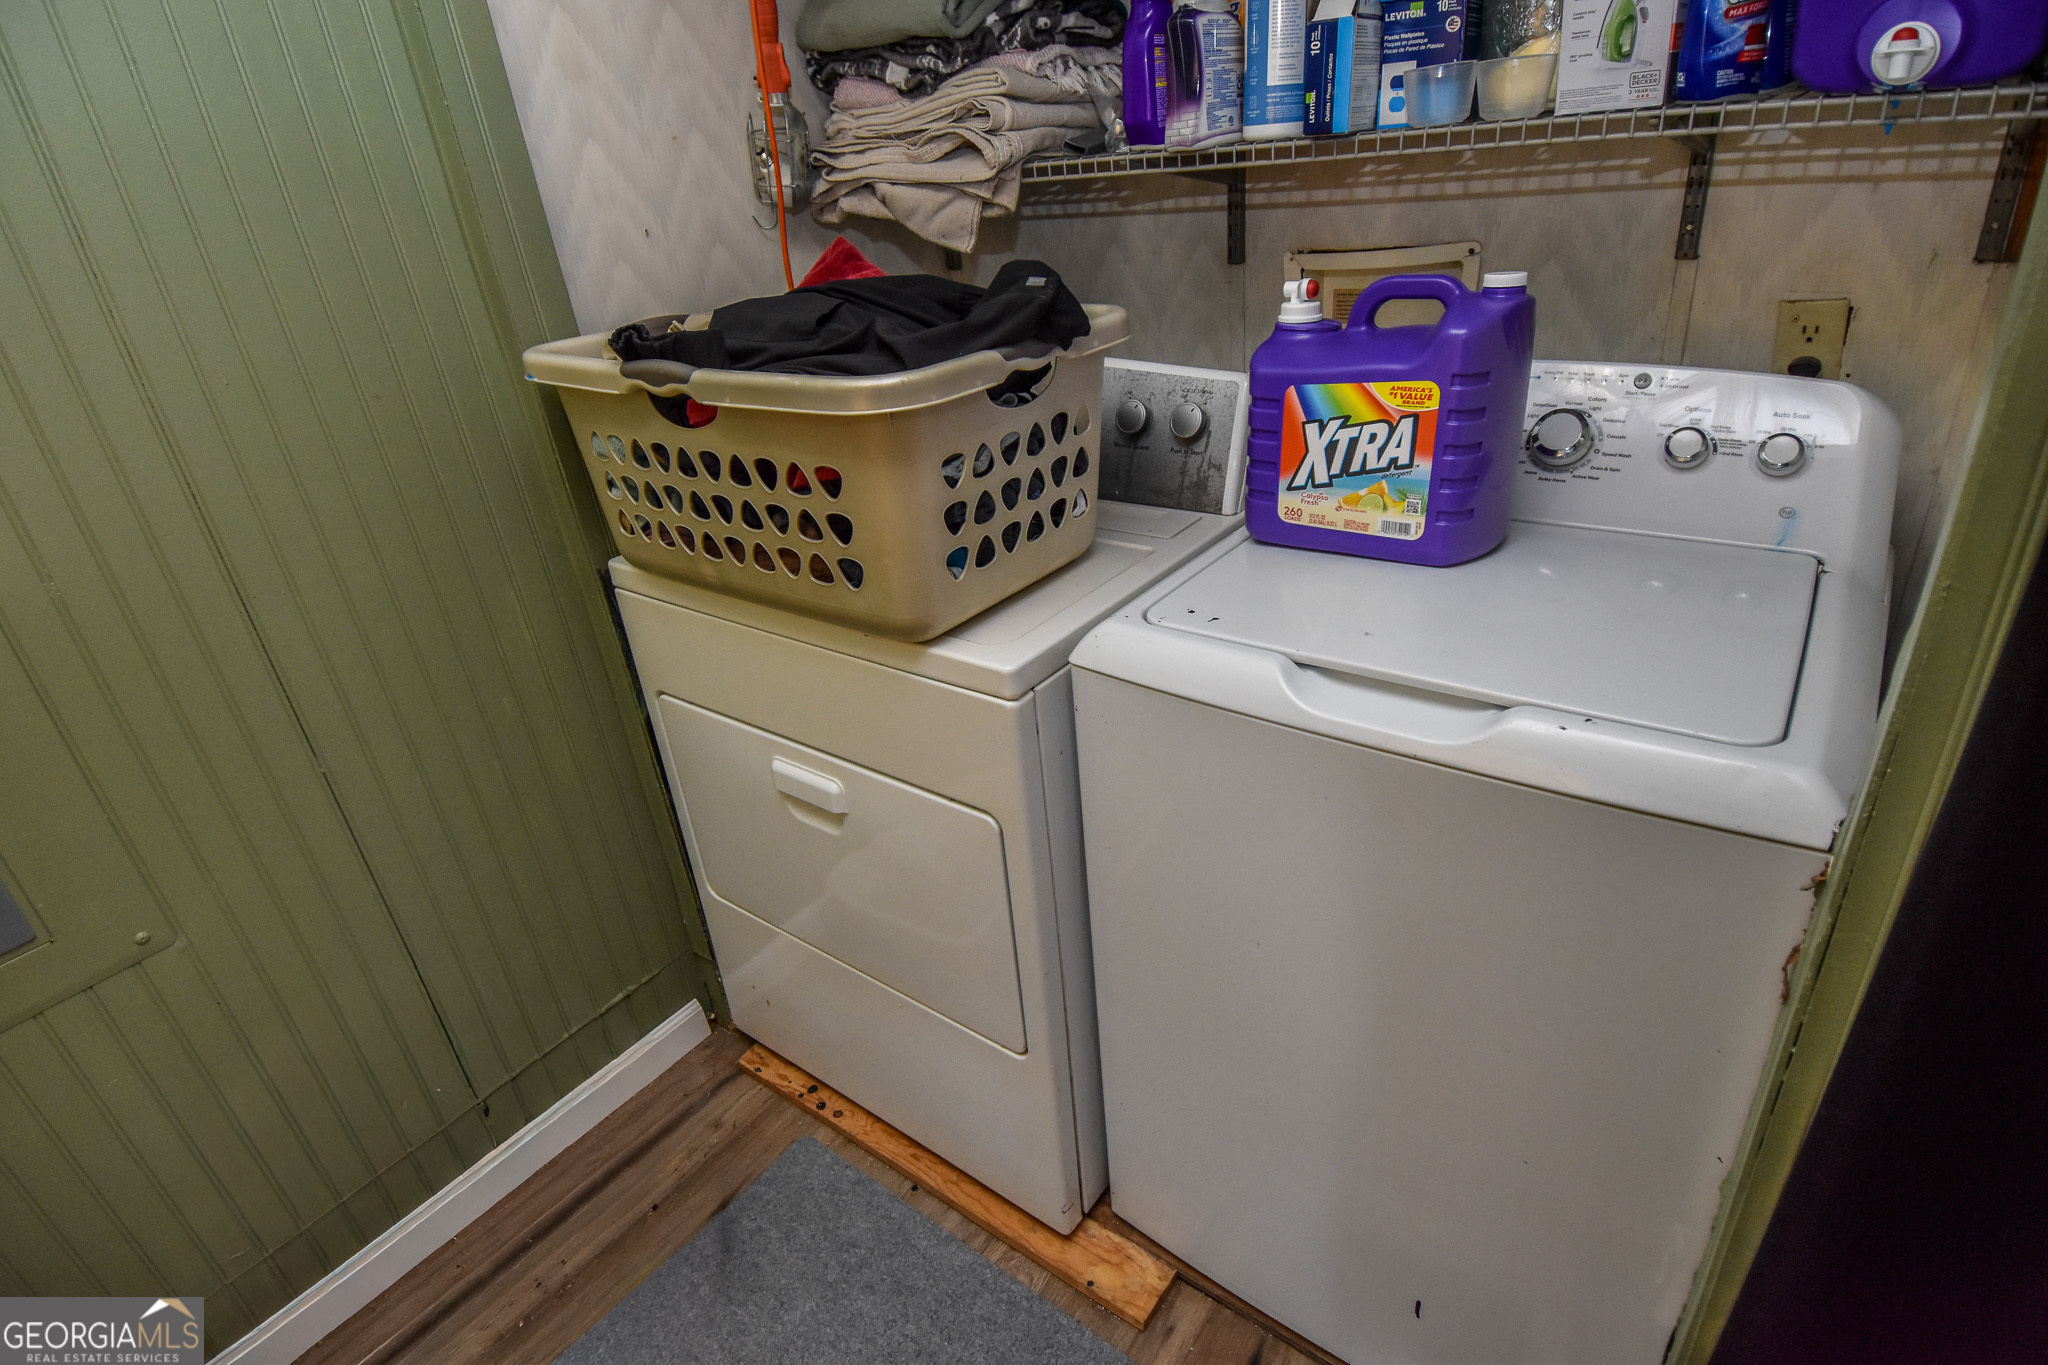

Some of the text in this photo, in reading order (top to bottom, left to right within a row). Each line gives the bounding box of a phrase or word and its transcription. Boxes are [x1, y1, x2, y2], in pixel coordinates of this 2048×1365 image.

[1437, 0, 1449, 12] 10
[1385, 9, 1425, 22] LEVITON
[1729, 7, 1748, 17] MAX
[1311, 41, 1321, 56] 10
[1632, 78, 1658, 86] DECKER
[1400, 392, 1434, 401] VALUE
[1684, 406, 1712, 414] Options
[1792, 412, 1811, 420] Soak
[1288, 414, 1419, 490] XTRA
[1381, 470, 1413, 479] detergent
[1300, 491, 1329, 501] Calypso
[1284, 506, 1303, 518] 260
